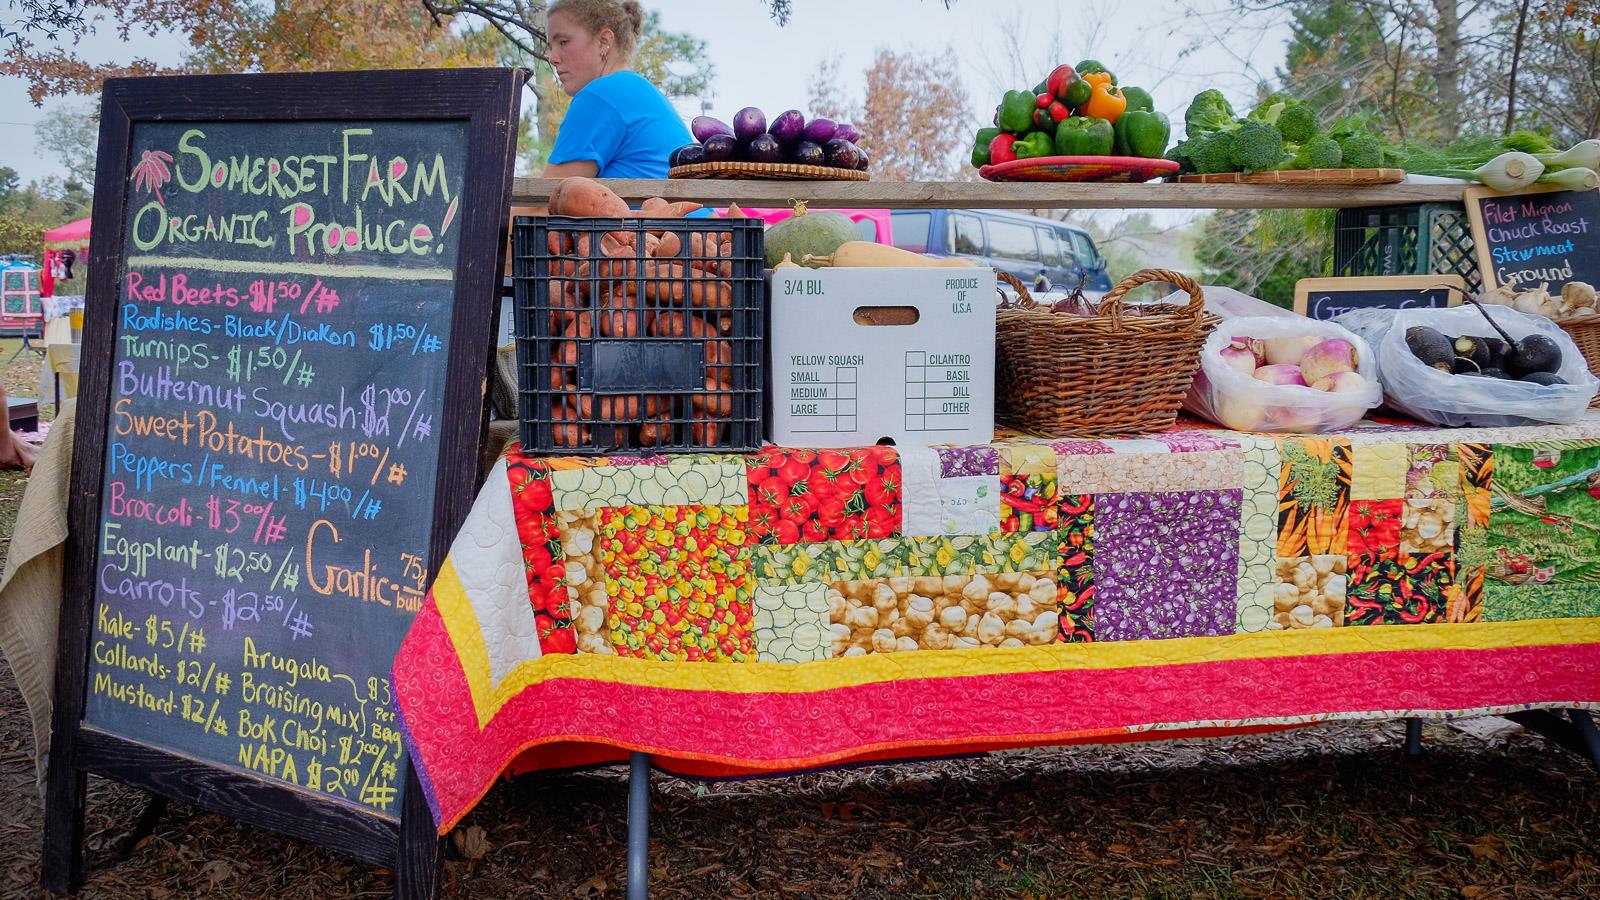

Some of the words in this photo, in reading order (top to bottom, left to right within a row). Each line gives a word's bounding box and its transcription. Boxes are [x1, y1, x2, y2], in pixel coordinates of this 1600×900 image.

[176, 129, 338, 199] SOMERSET
[342, 128, 451, 207] FARM
[1484, 201, 1517, 225] Filet
[1521, 202, 1573, 219] Mignon
[132, 201, 276, 250] ORGANIC
[1488, 222, 1541, 243] Chuck
[1542, 217, 1590, 234] Roast
[1497, 259, 1573, 286] Ground
[126, 271, 166, 301] Red
[784, 279, 803, 295] 3/4
[806, 280, 825, 295] BU.
[945, 278, 978, 290] PRODUCE
[957, 291, 967, 301] OF
[790, 355, 826, 366] YELLOW
[828, 355, 864, 366] SQUASH
[929, 354, 971, 365] CILANTRO
[790, 371, 820, 382] SMALL
[946, 370, 970, 381] BASIL
[118, 360, 247, 413] Butternut
[790, 387, 828, 398] MEDIUM
[953, 386, 970, 397] DILL
[790, 404, 818, 414] LARGE
[942, 402, 970, 413] OTHER
[113, 398, 195, 446] Sweet
[242, 636, 331, 687] Arugala
[368, 677, 391, 705] $3
[240, 672, 323, 733] Braising
[325, 701, 359, 732] Mix
[374, 706, 396, 722] Per
[238, 743, 298, 784] NAPA
